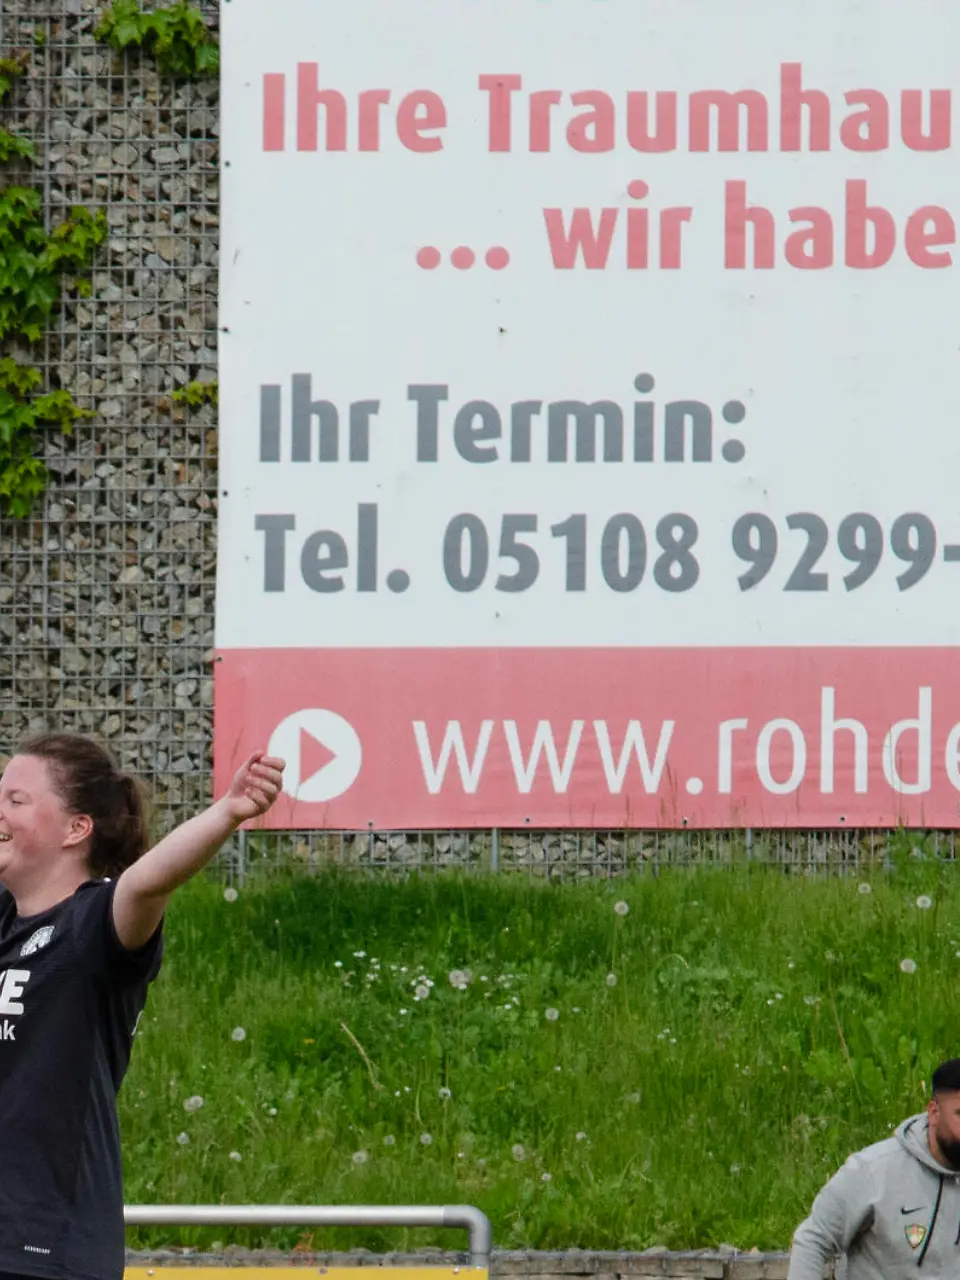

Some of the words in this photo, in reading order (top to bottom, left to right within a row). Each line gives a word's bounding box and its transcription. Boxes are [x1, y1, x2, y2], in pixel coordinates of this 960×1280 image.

[262, 62, 448, 153] Ihre
[478, 62, 953, 153] Traumhau
[416, 246, 510, 270] ...
[543, 180, 693, 270] wir
[724, 179, 958, 270] habe
[259, 373, 380, 463] Ihr
[407, 373, 747, 464] Termin:
[254, 503, 411, 594] Tel.
[442, 512, 700, 593] 05108
[731, 512, 960, 592] 9299-
